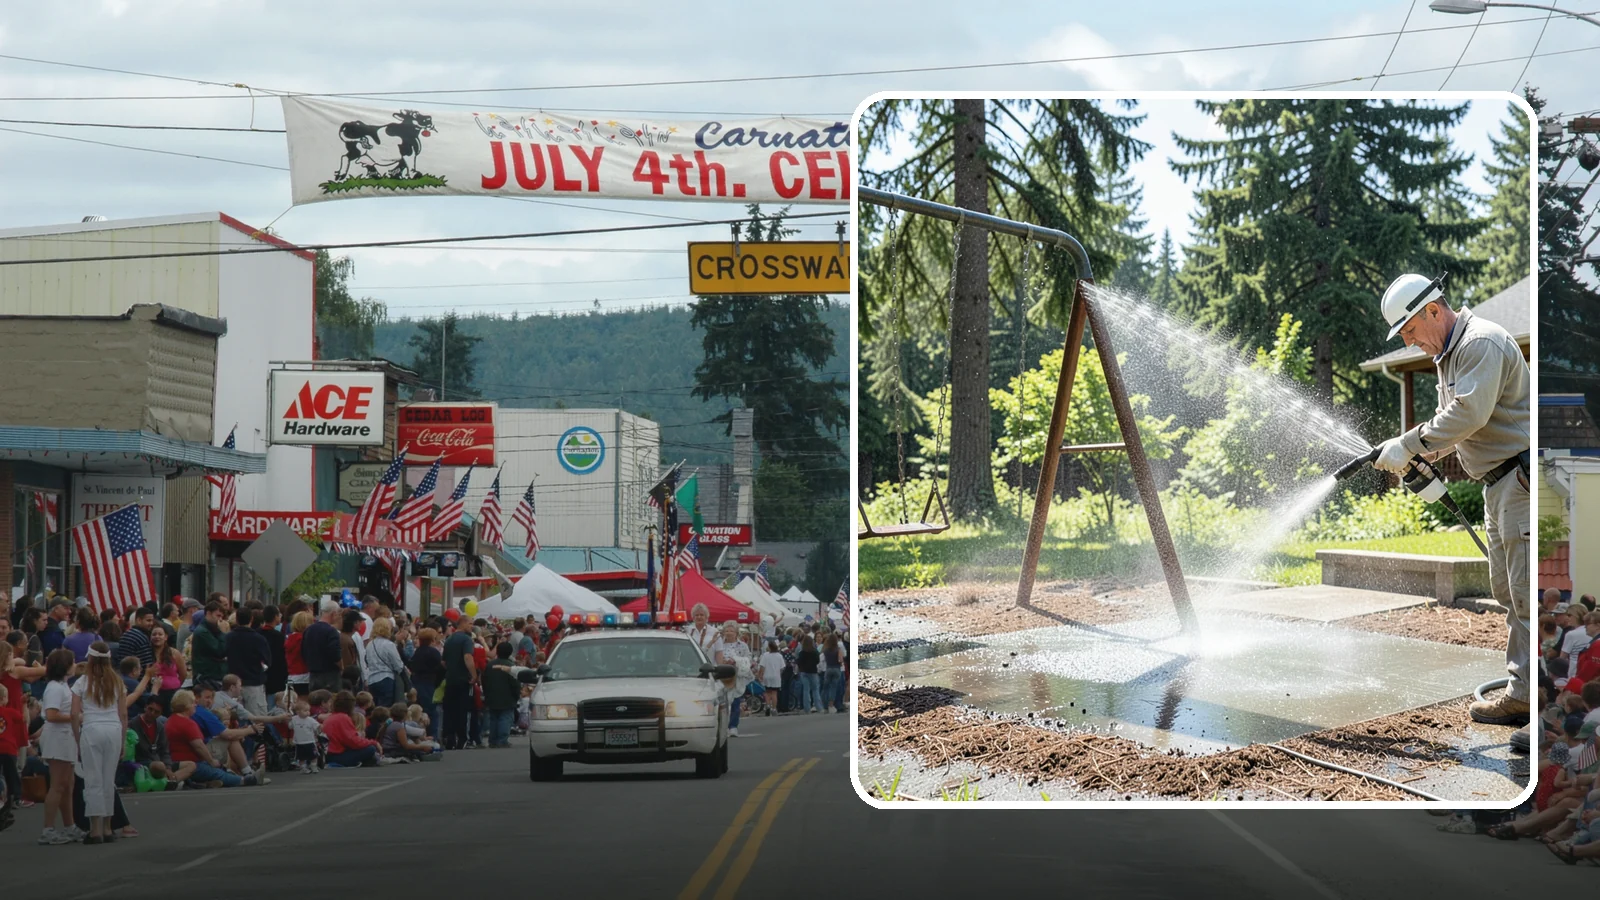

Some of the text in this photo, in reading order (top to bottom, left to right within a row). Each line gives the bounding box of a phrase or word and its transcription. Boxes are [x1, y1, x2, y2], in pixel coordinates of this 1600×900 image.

[481, 141, 605, 192] JULY
[632, 148, 746, 198] 4th.
[696, 253, 850, 280] CROSSWA
[283, 379, 373, 420] ACE
[406, 409, 485, 422] CEDAR LOG
[283, 421, 371, 436] Hardware
[416, 428, 477, 447] Coca-Cola
[83, 484, 155, 496] St. Vincent de Paul
[699, 535, 730, 543] GLASS
